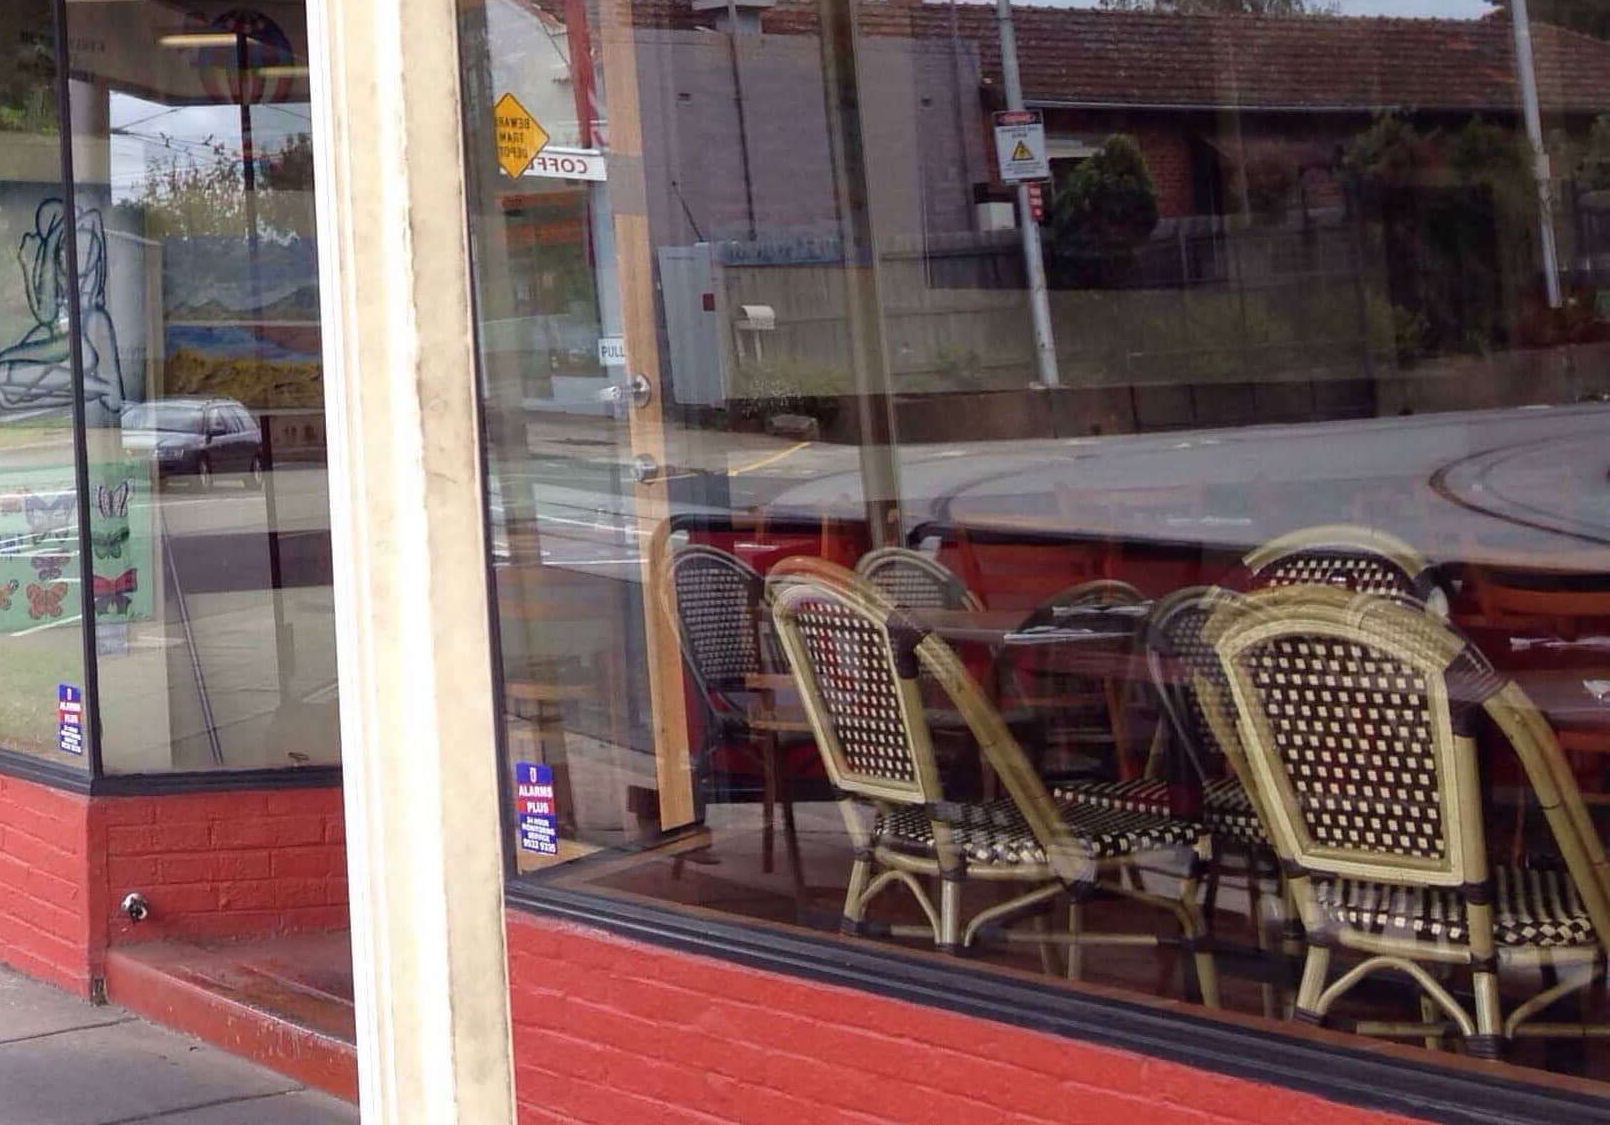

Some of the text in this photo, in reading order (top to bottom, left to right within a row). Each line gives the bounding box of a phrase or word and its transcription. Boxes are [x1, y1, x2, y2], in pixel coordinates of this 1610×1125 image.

[601, 345, 626, 358] PULL
[518, 784, 553, 798] ALARMS
[526, 802, 550, 814] PLUS
